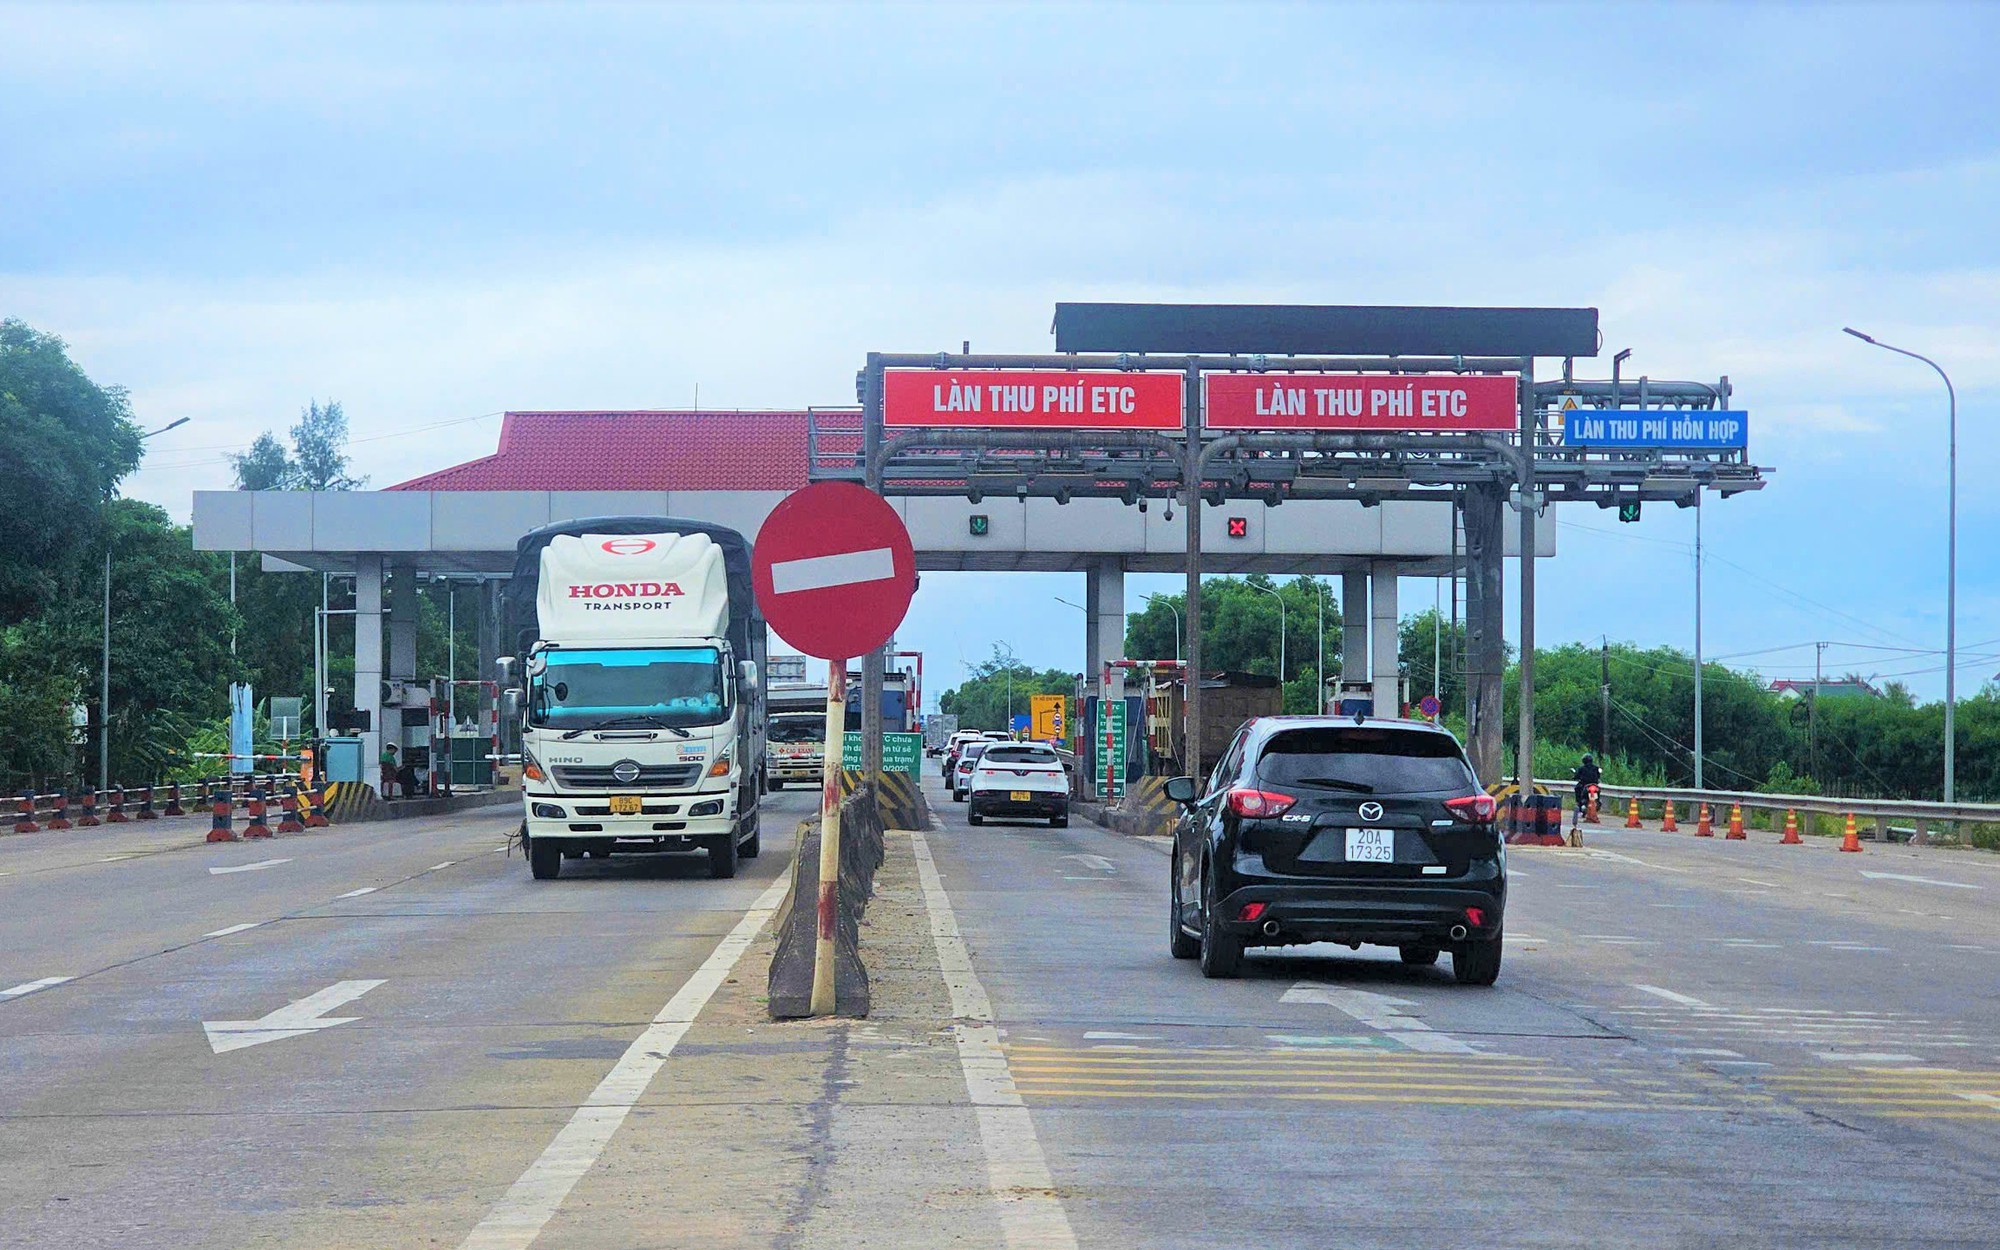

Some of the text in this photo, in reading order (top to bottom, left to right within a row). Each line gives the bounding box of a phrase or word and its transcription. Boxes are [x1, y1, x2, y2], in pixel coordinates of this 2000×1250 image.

[934, 379, 1135, 413] LÀN THU PHÍ ETC
[1255, 383, 1467, 417] LÀN THU PHÍ ETC
[1574, 414, 1739, 443] LÀN THU PHÍ HỖN HỢP
[568, 582, 685, 598] HONDA
[584, 602, 672, 610] TRANSPORT
[1282, 814, 1311, 822] CX-5
[1358, 830, 1382, 845] 20A
[1350, 845, 1391, 861] 173.25
